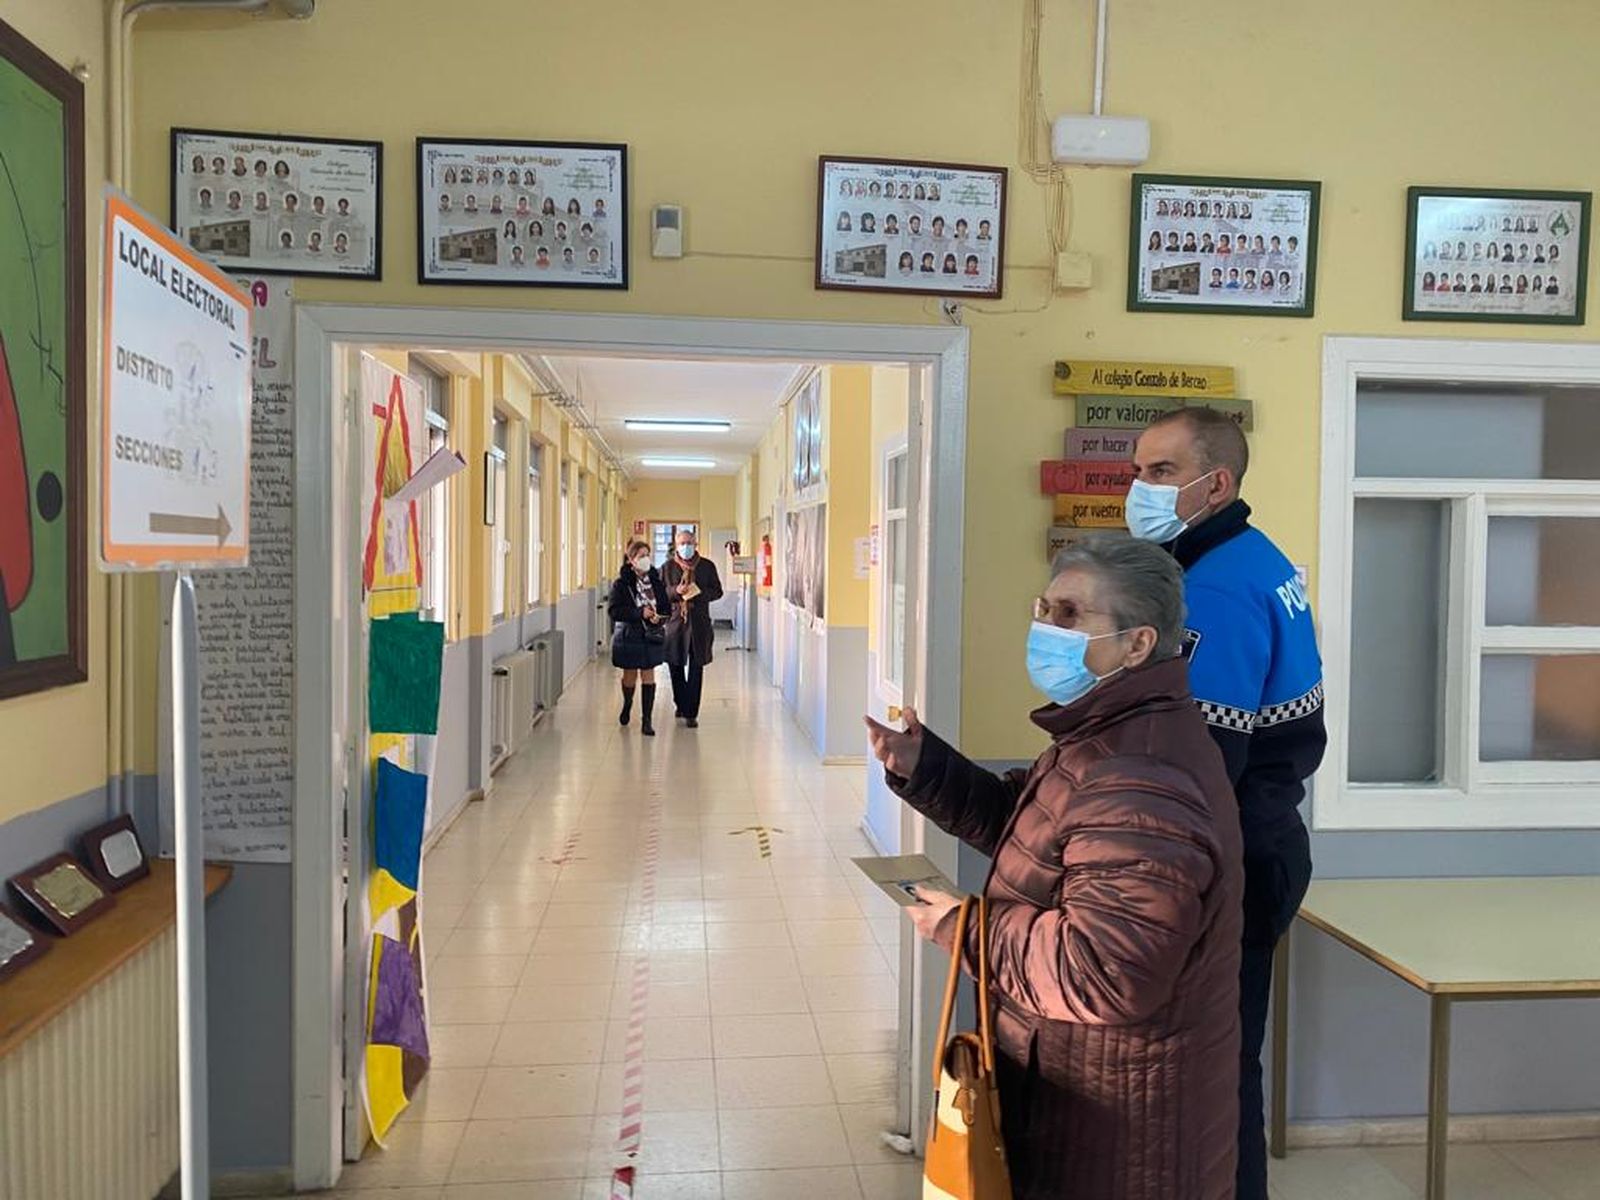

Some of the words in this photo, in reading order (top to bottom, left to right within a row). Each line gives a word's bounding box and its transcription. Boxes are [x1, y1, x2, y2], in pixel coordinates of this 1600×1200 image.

[120, 231, 167, 288] LOCAL
[171, 266, 236, 331] ELECTORAL
[116, 344, 174, 392] DISTRITO
[1092, 368, 1104, 385] Al
[1104, 370, 1133, 390] colegio
[1134, 369, 1168, 388] Gonzalo
[1169, 371, 1179, 388] de
[1181, 371, 1208, 390] Berceo
[1086, 405, 1112, 424] por
[115, 433, 184, 472] SECCIONES
[1082, 438, 1099, 454] por
[1102, 436, 1129, 453] hacer
[1085, 472, 1100, 489] por
[1072, 504, 1089, 520] por
[1090, 504, 1122, 519] vuestra
[1275, 574, 1307, 620] POL
